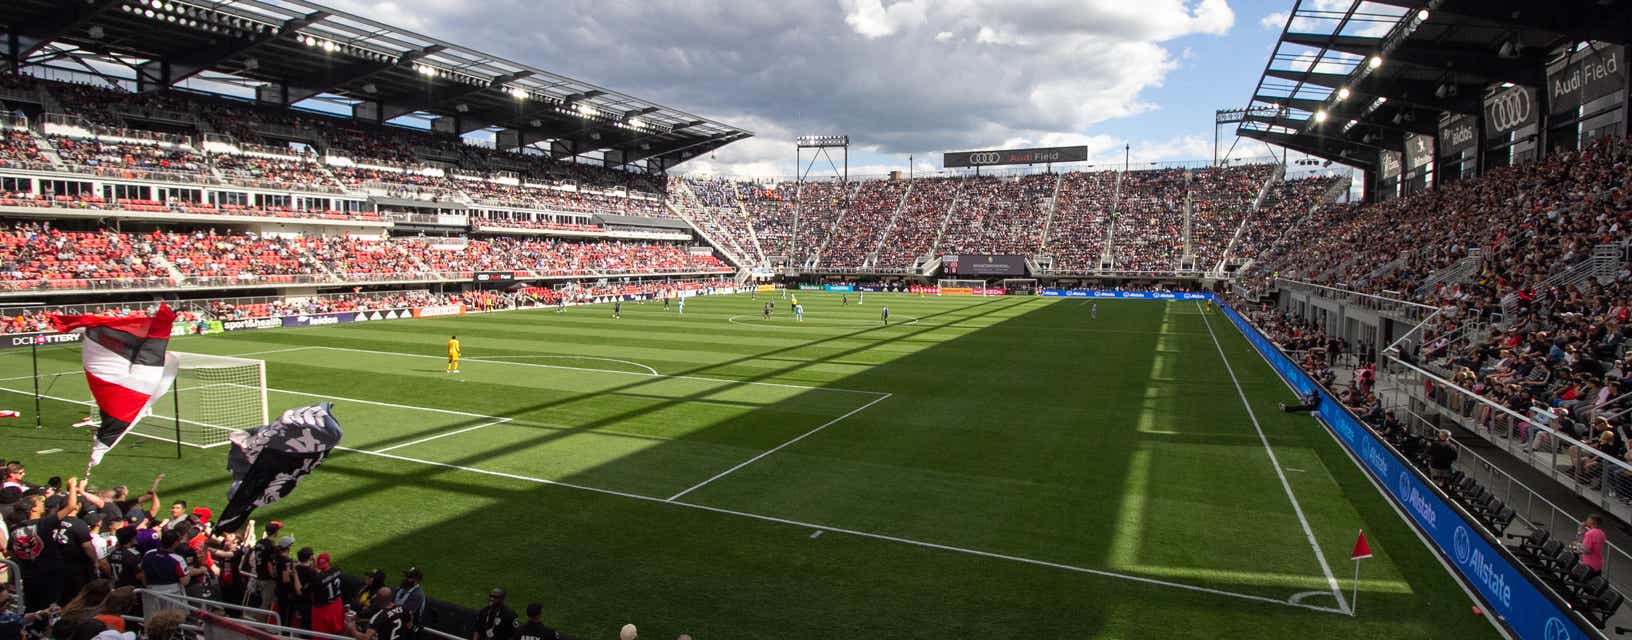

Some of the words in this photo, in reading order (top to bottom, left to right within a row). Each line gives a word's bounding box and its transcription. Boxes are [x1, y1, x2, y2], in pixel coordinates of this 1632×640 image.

[1554, 70, 1580, 98] Audi
[1584, 53, 1617, 85] Field
[1009, 152, 1033, 161] Audi
[1034, 151, 1059, 161] Field
[224, 317, 282, 331] sport&health
[309, 316, 338, 326] leidos
[1409, 487, 1437, 526] Allstate
[1469, 548, 1511, 608] Allstate
[390, 618, 402, 640] 2
